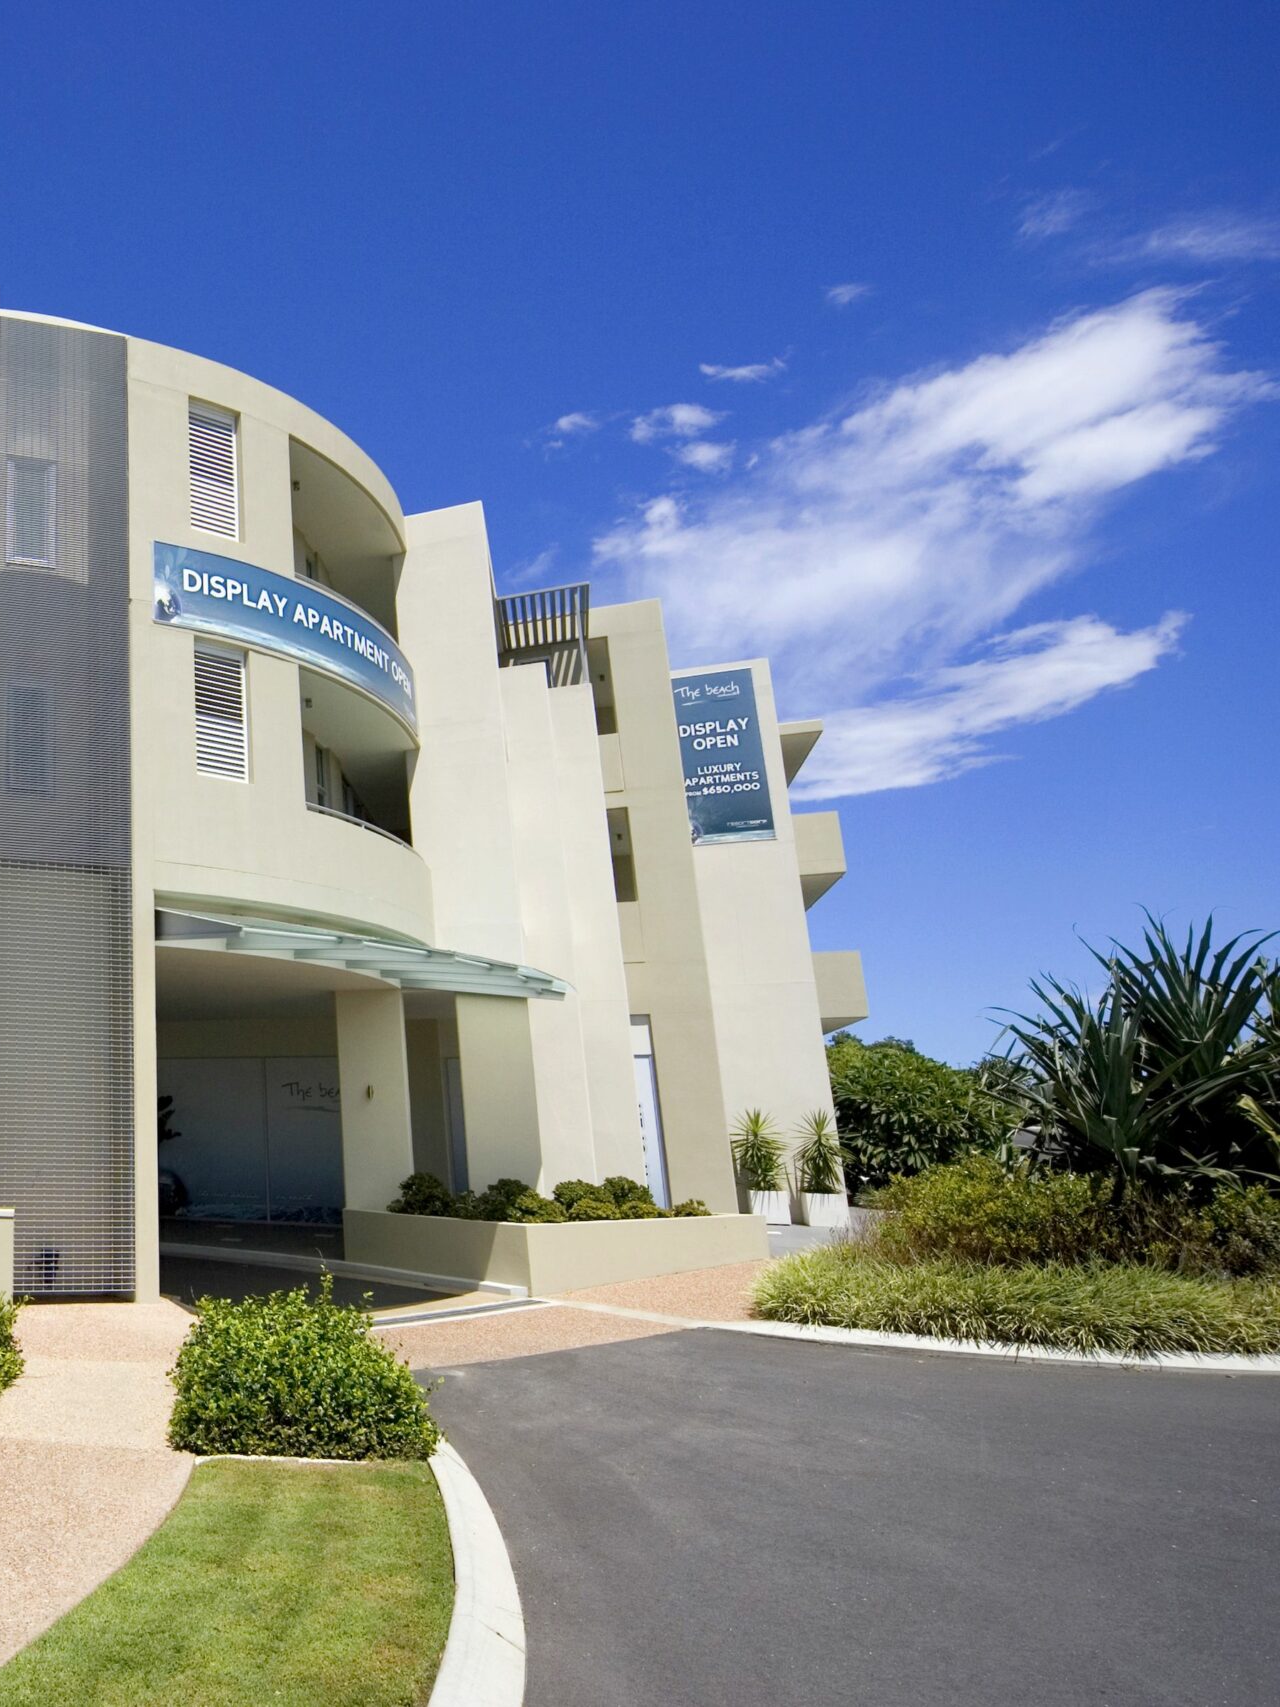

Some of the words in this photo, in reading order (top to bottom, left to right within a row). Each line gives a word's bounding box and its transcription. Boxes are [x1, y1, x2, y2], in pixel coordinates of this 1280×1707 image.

[182, 568, 288, 618] DISPLAY
[293, 603, 390, 673] APARTMENT
[391, 660, 412, 700] OPEN
[673, 685, 701, 700] The
[679, 717, 749, 738] DISPLAY
[693, 734, 739, 750] OPEN
[697, 762, 742, 776] LUXURY
[685, 771, 759, 787] APARTMENTS
[702, 782, 761, 795] $650,000
[281, 1082, 313, 1101] The
